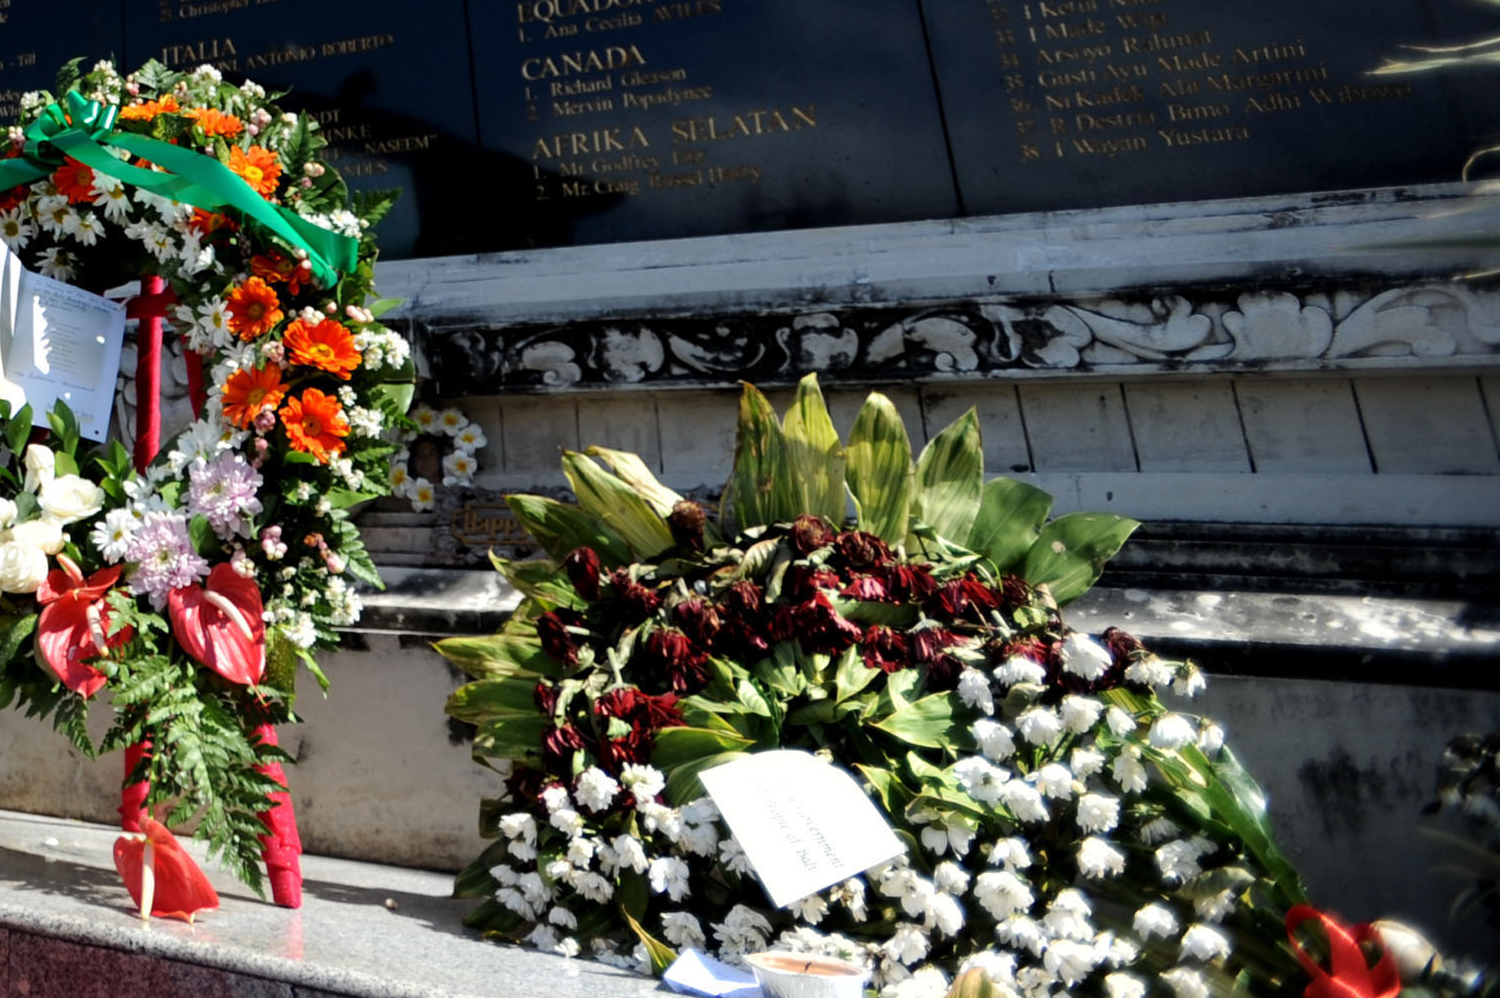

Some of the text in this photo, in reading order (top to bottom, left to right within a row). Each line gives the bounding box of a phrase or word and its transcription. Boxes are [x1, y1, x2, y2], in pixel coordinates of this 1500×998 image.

[544, 22, 578, 40] Ana
[161, 37, 237, 67] ITALIA
[521, 44, 648, 82] CANADA
[550, 75, 612, 98] Richard
[532, 105, 818, 161] AFRIKA SELATAN
